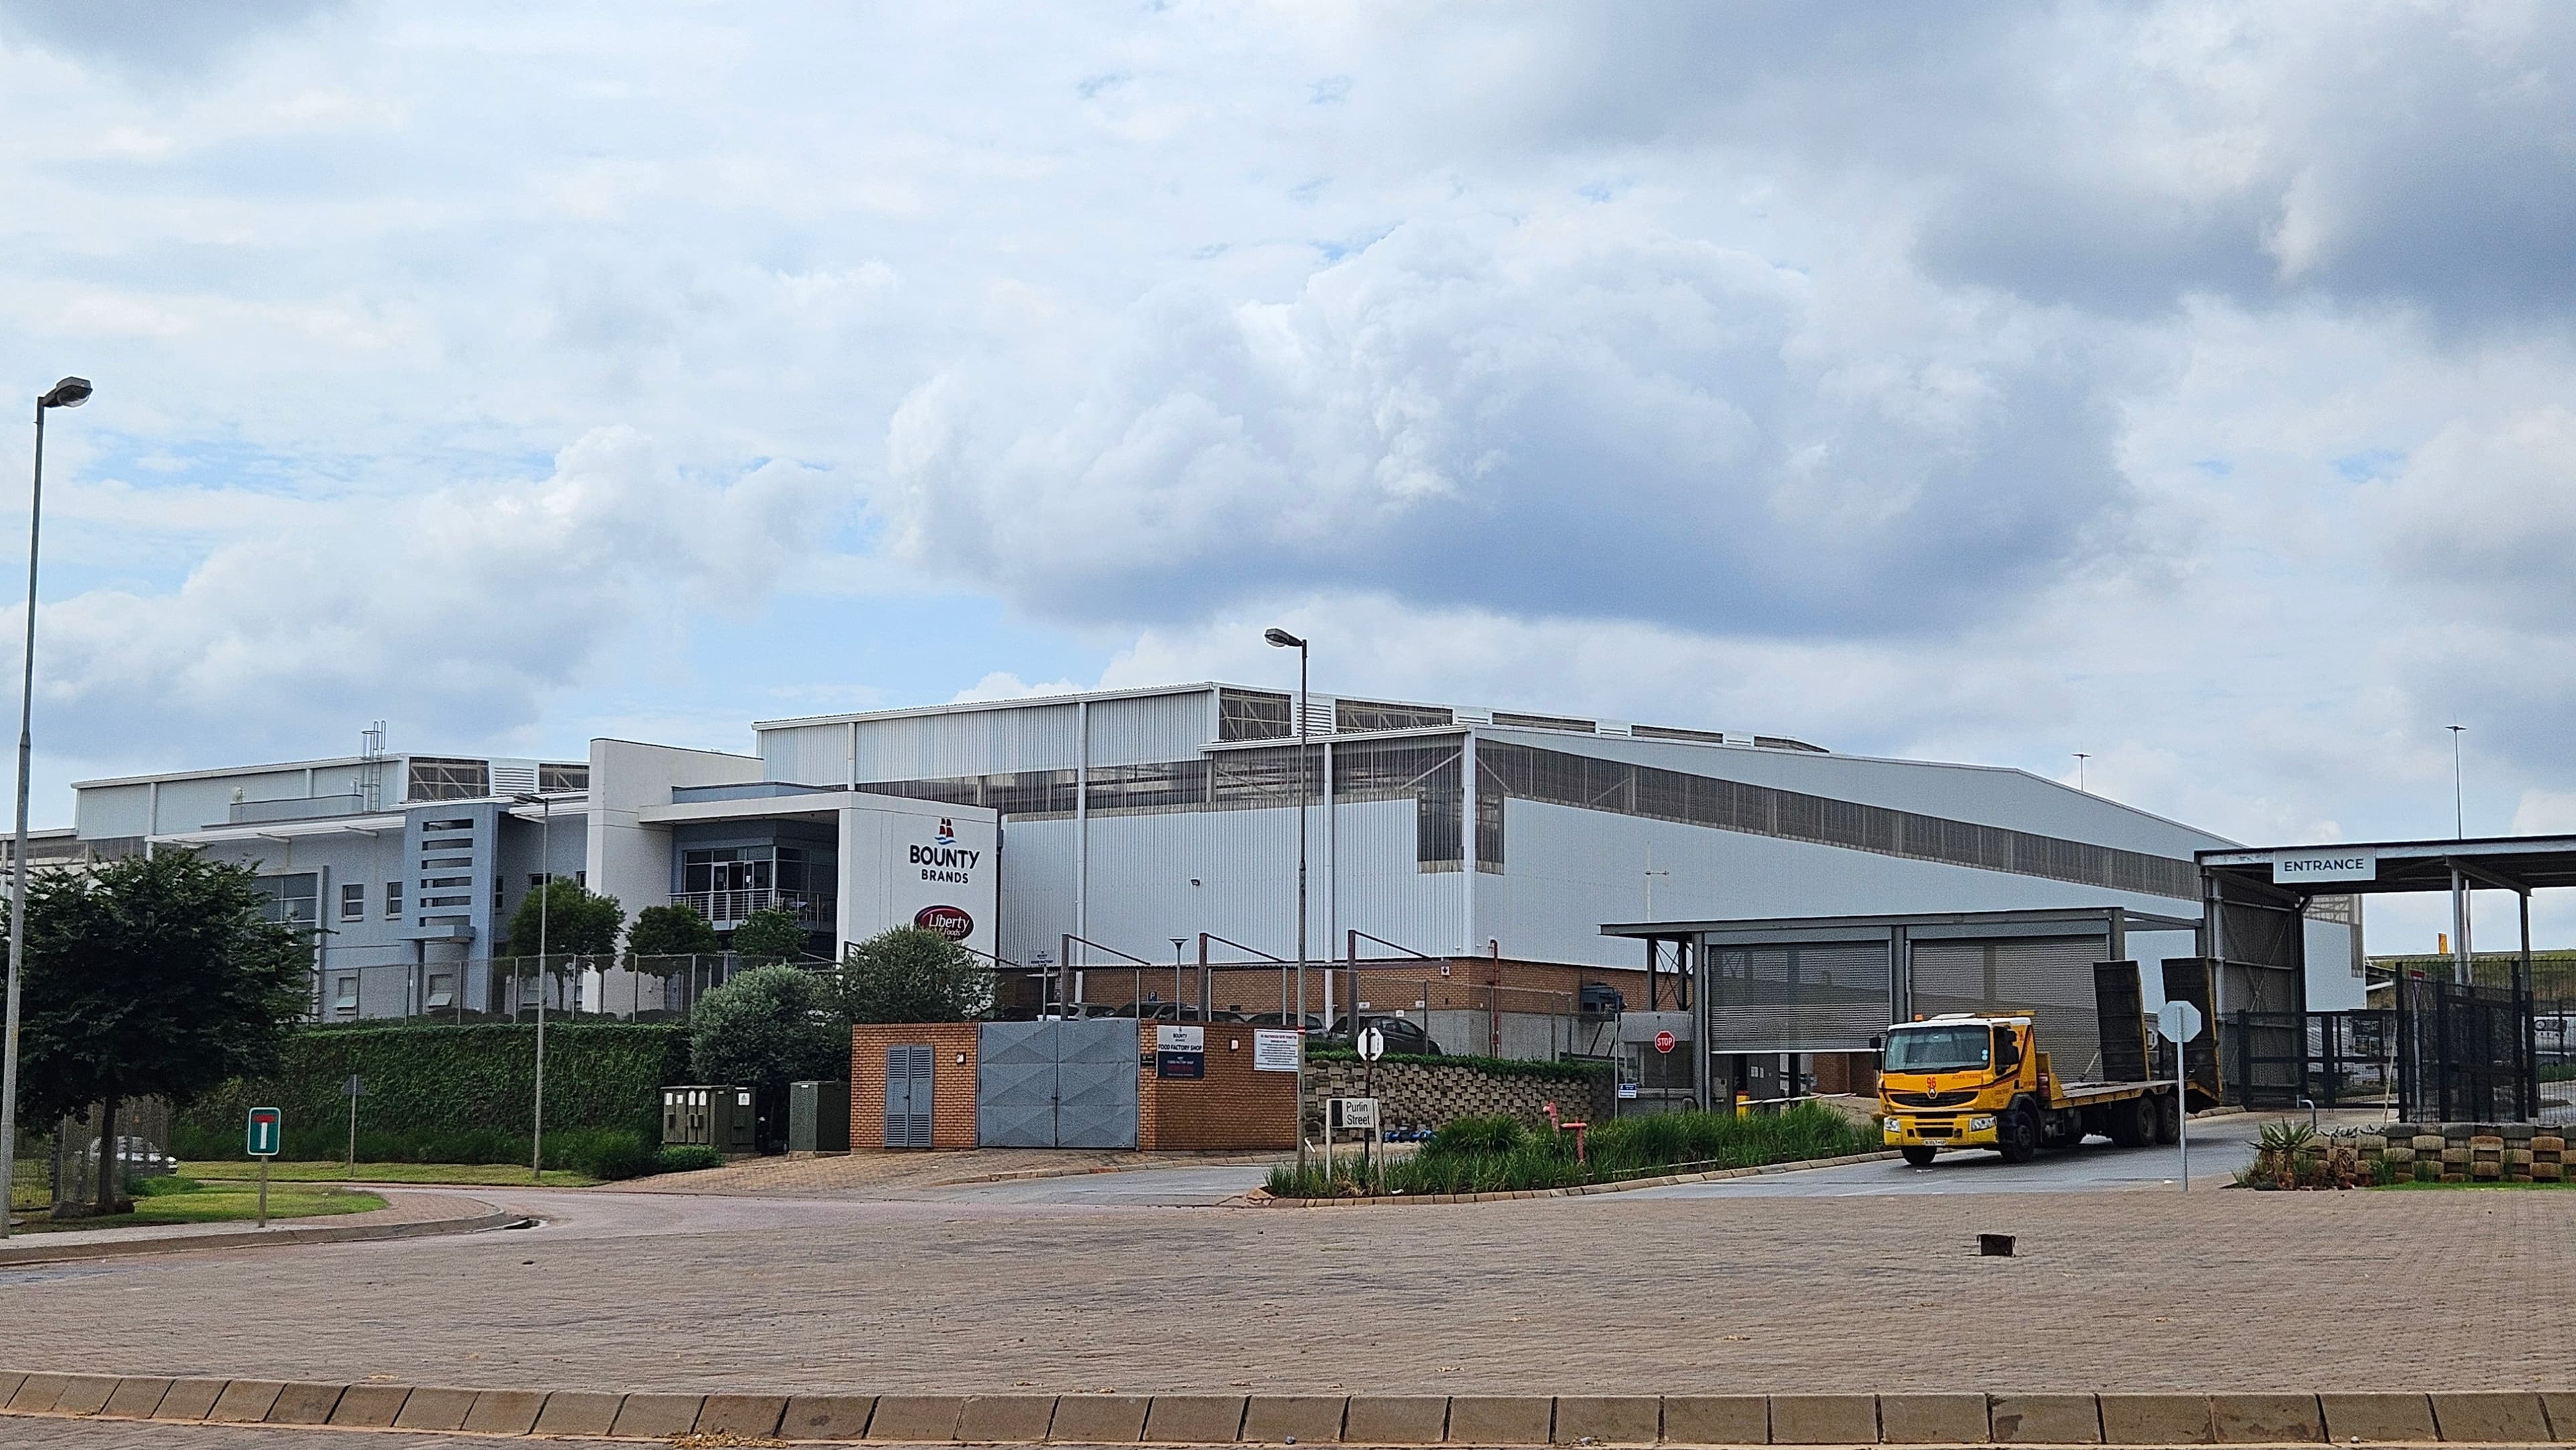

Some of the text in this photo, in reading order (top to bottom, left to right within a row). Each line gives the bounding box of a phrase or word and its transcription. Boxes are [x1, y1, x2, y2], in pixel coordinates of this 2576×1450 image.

[910, 844, 980, 869] BOUNTY
[2284, 858, 2364, 872] ENTRANCE
[921, 869, 969, 884] BRANDS
[928, 913, 969, 933] Liberty
[944, 928, 961, 936] Foods
[1657, 1038, 1672, 1046] STOP
[1927, 1077, 1937, 1088] 96
[1346, 1101, 1368, 1112] Purlin
[1347, 1114, 1370, 1125] Street
